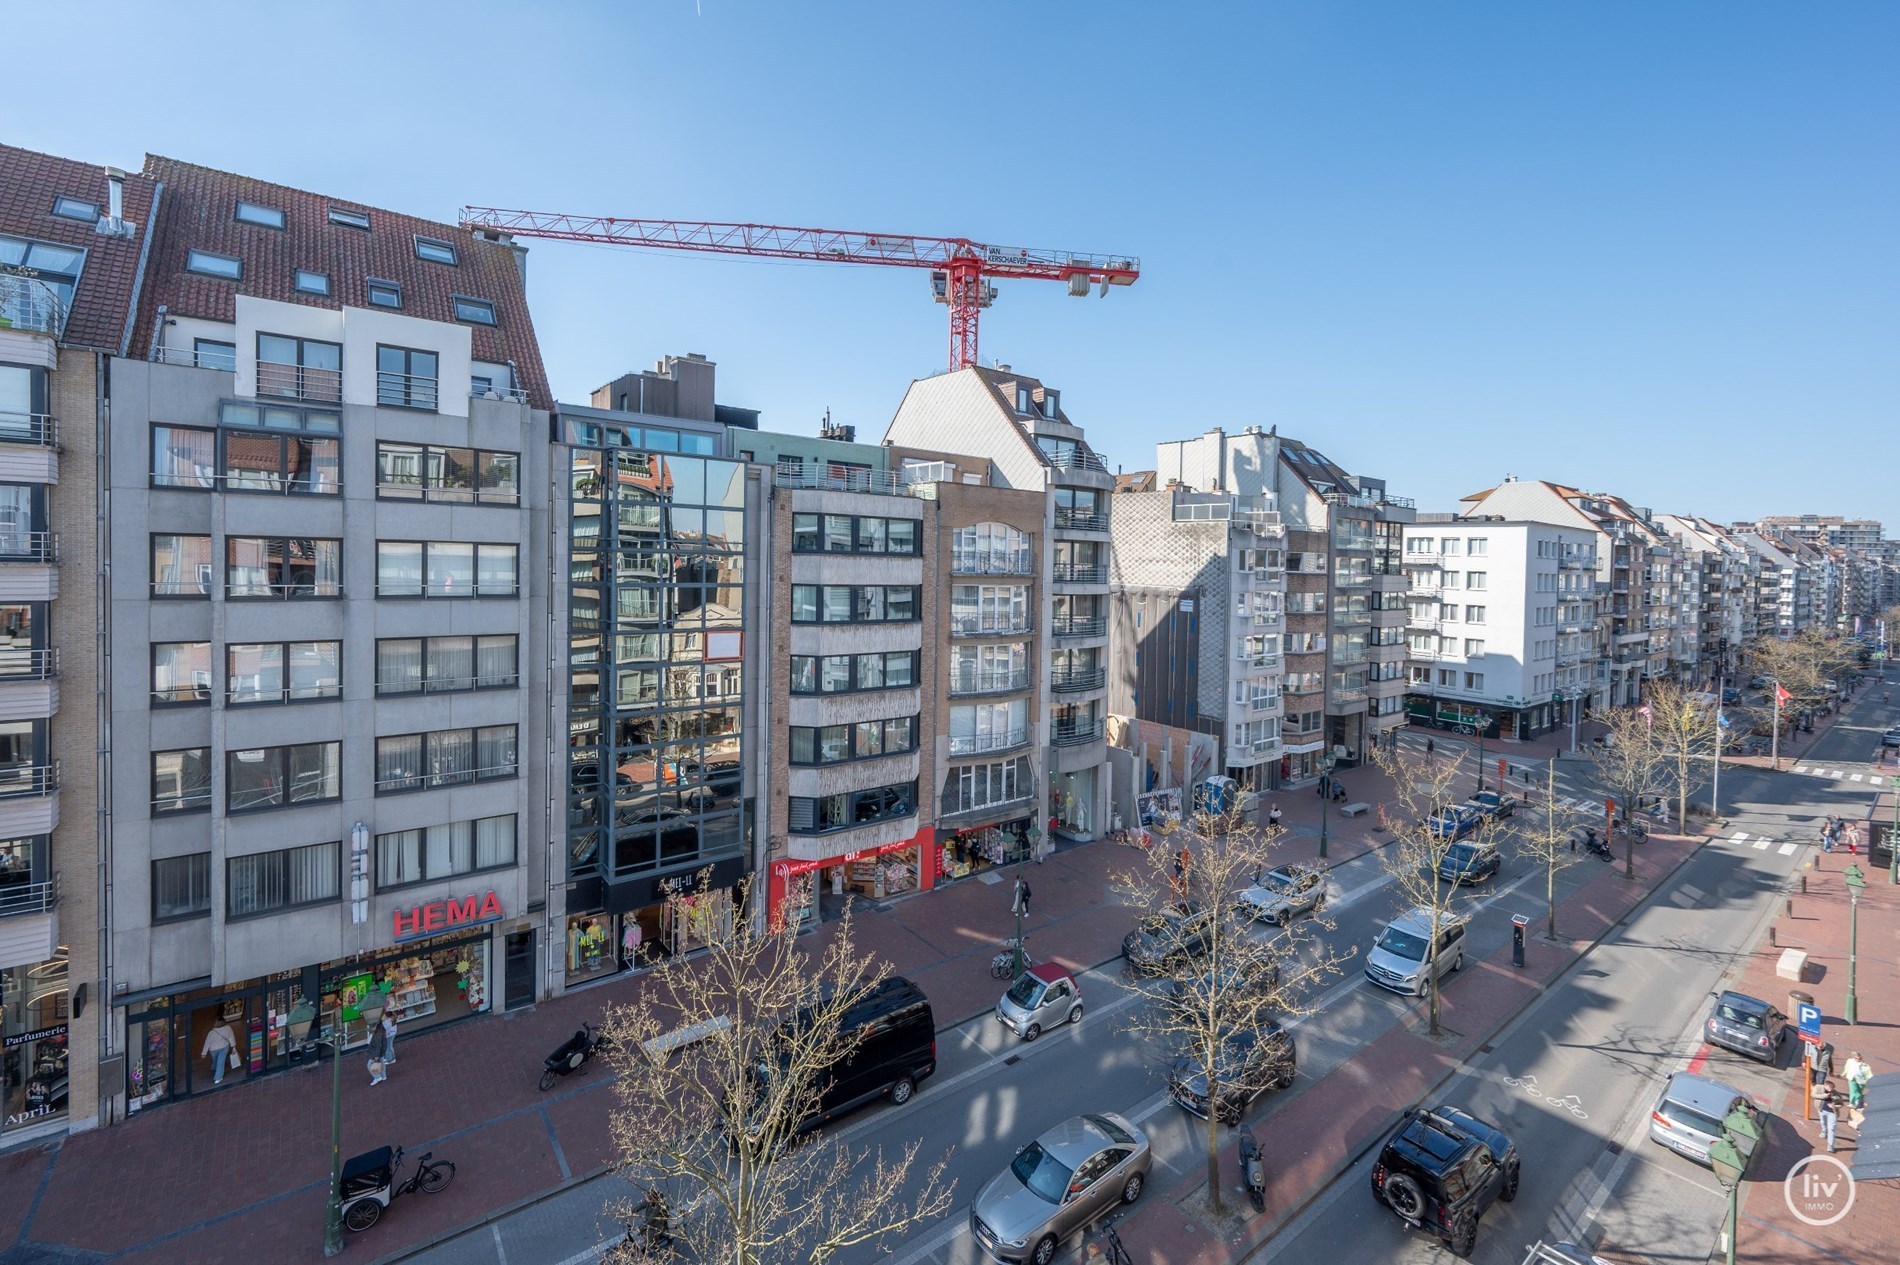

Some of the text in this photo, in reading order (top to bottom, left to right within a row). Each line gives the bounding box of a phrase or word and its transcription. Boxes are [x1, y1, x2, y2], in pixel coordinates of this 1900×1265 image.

[987, 254, 1028, 265] KERSCHAEVER
[988, 247, 1001, 255] VAN
[393, 889, 503, 937] HEMA
[1801, 1006, 1818, 1023] P
[5, 1026, 66, 1046] Parfumerie
